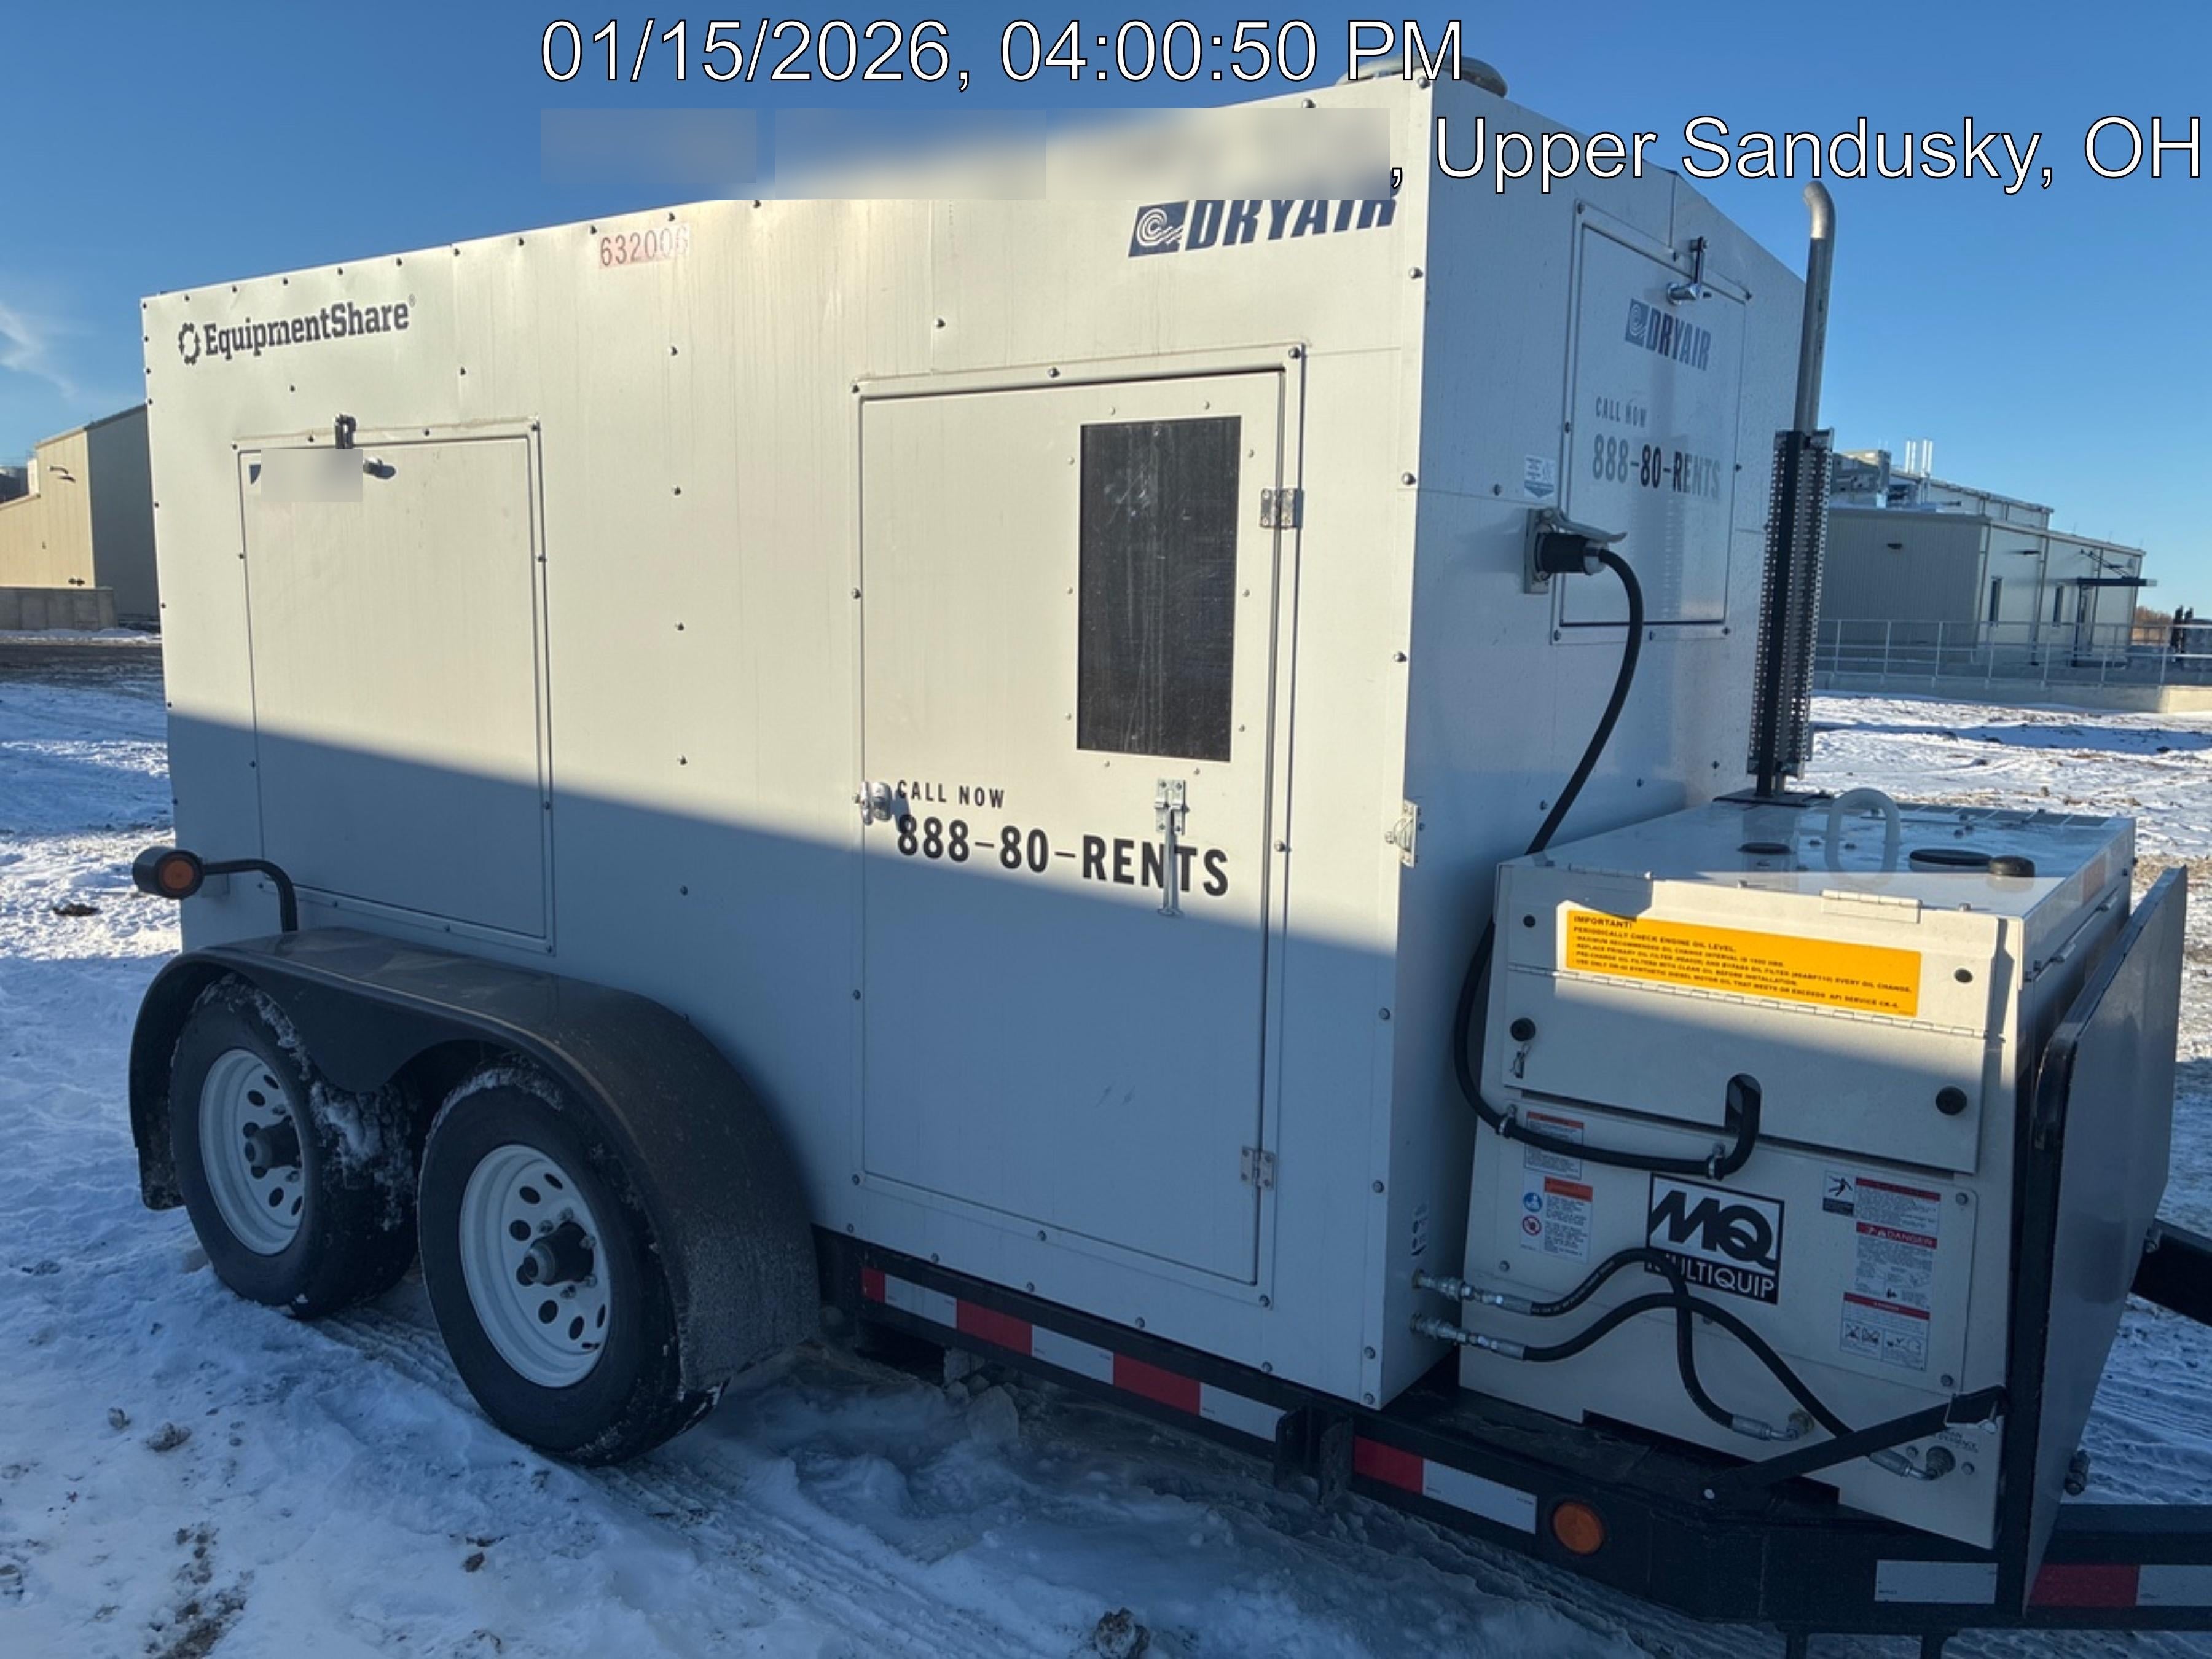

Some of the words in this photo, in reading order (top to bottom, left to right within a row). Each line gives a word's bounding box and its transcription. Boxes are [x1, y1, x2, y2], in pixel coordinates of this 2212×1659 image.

[203, 302, 409, 360] EquipmentShare
[1646, 307, 1712, 371] DRYAIR
[1596, 396, 1621, 422] CALL
[1625, 401, 1647, 428] NOW
[1592, 434, 1720, 500] 888-80-RENTS
[897, 780, 947, 803] CALL
[959, 785, 1005, 809] NOW
[897, 814, 1229, 896] 888-80-RENTS
[1574, 915, 1631, 929] IMPORTANT!
[1574, 927, 1627, 938] PERIODICALLY
[1650, 1190, 1778, 1271] MQ
